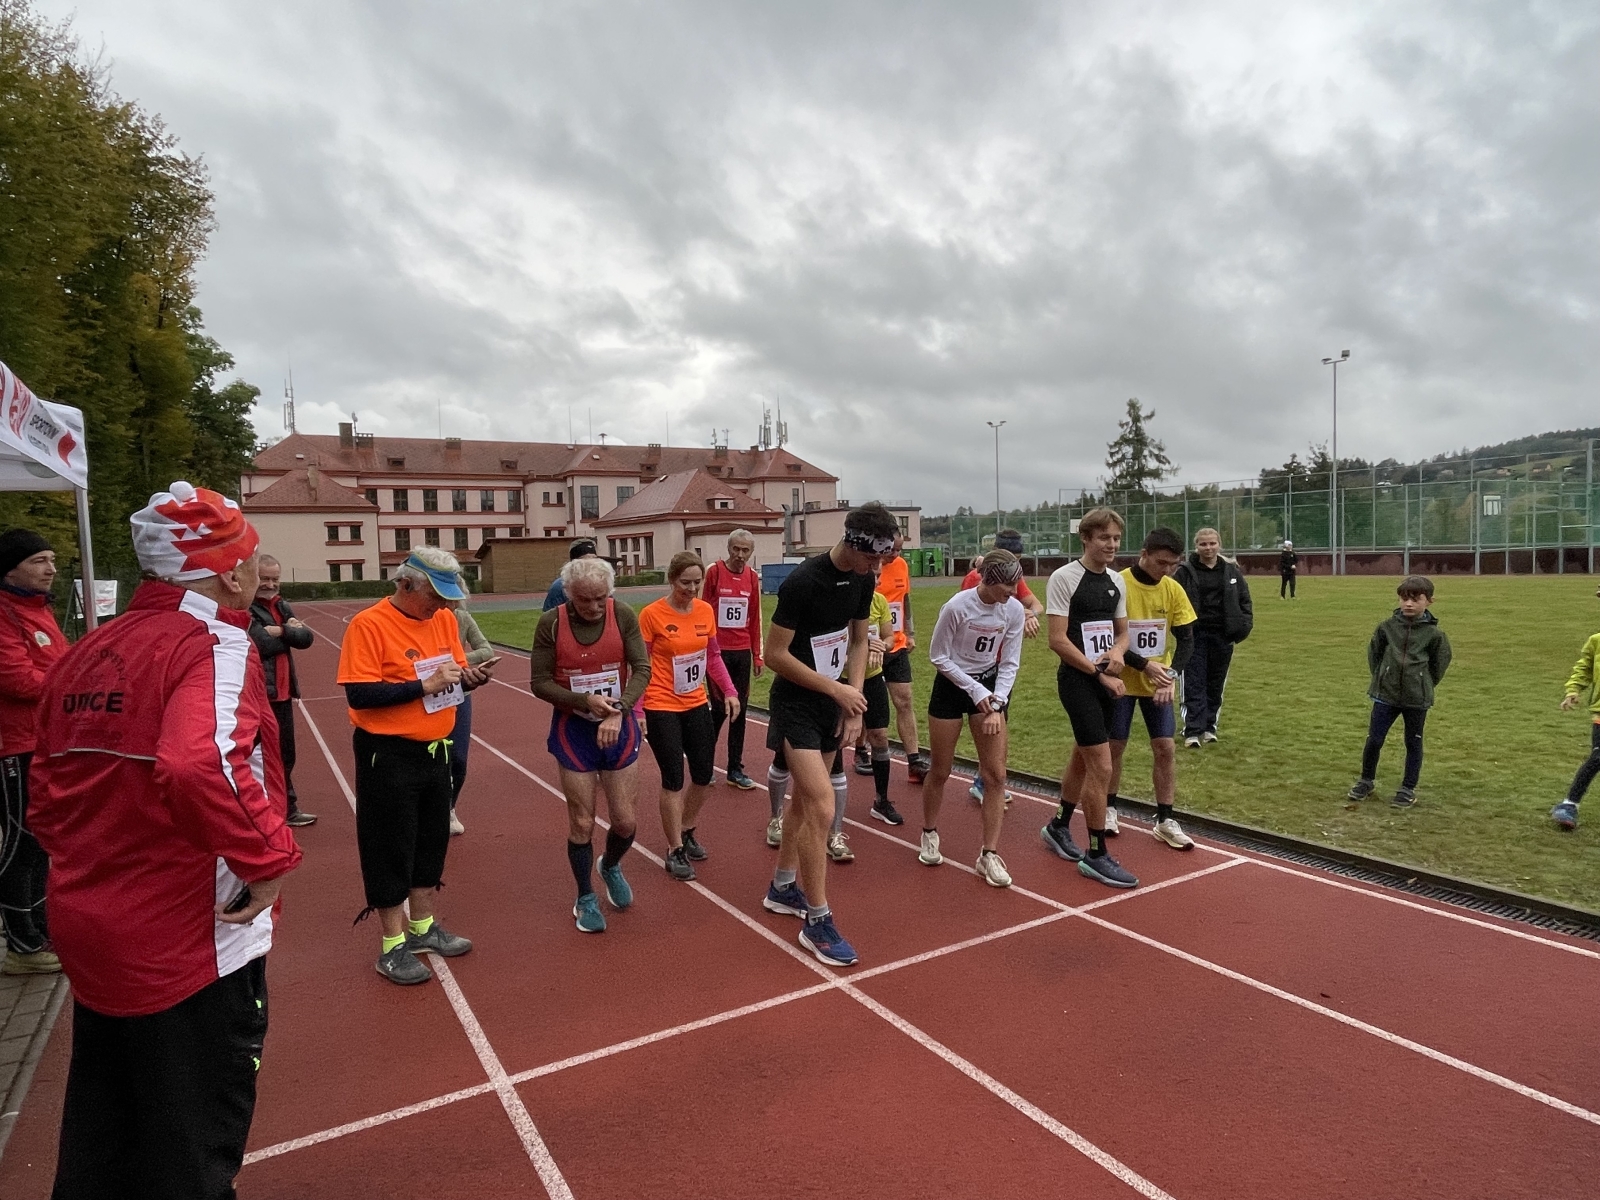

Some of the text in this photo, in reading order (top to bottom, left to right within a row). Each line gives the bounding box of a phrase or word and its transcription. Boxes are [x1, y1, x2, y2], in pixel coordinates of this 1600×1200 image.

[726, 606, 742, 621] 65
[974, 635, 996, 653] 61
[1089, 634, 1113, 654] 149
[1137, 631, 1158, 649] 66
[830, 647, 840, 669] 4
[684, 663, 700, 683] 19
